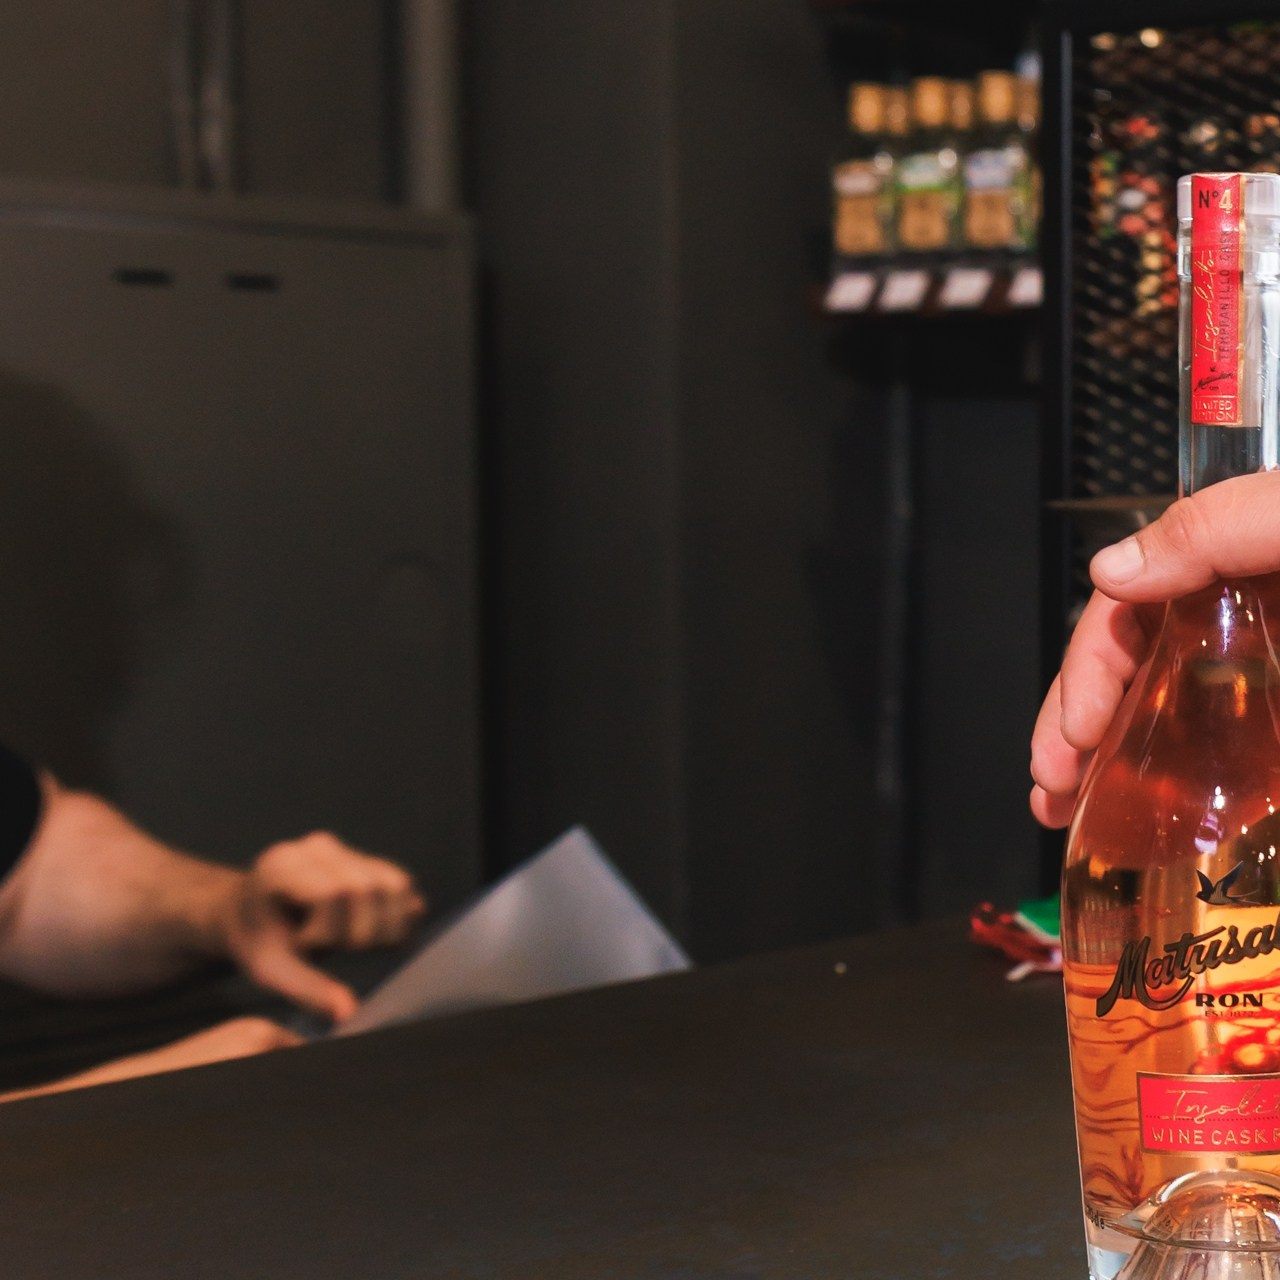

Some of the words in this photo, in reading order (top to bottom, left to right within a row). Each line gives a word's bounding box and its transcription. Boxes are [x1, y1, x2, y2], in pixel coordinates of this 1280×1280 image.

[1195, 993, 1263, 1007] RON
[1151, 1126, 1205, 1145] WINE
[1211, 1129, 1268, 1146] CASK
